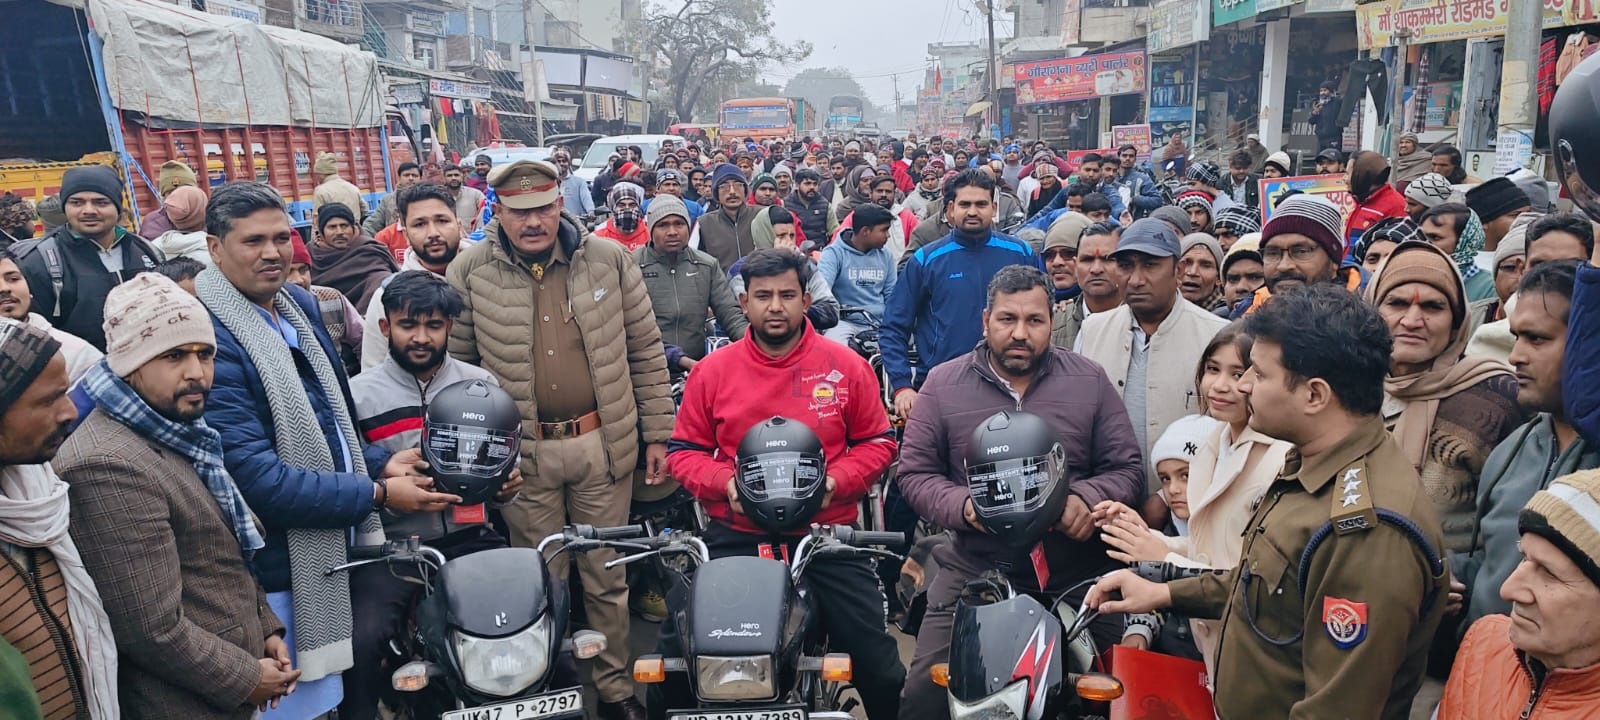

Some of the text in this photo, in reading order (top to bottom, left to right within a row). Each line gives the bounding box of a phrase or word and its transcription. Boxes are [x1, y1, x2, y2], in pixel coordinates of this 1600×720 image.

[1219, 0, 1245, 11] opp
[1378, 5, 1391, 32] माँ
[1102, 54, 1129, 69] पार्लर
[859, 268, 884, 280] ANGELES
[462, 411, 486, 422] Hero
[766, 440, 788, 448] Hero
[987, 444, 1010, 455] Hero
[994, 492, 1013, 501] Hero
[516, 704, 525, 717] P
[539, 694, 577, 714] 2797
